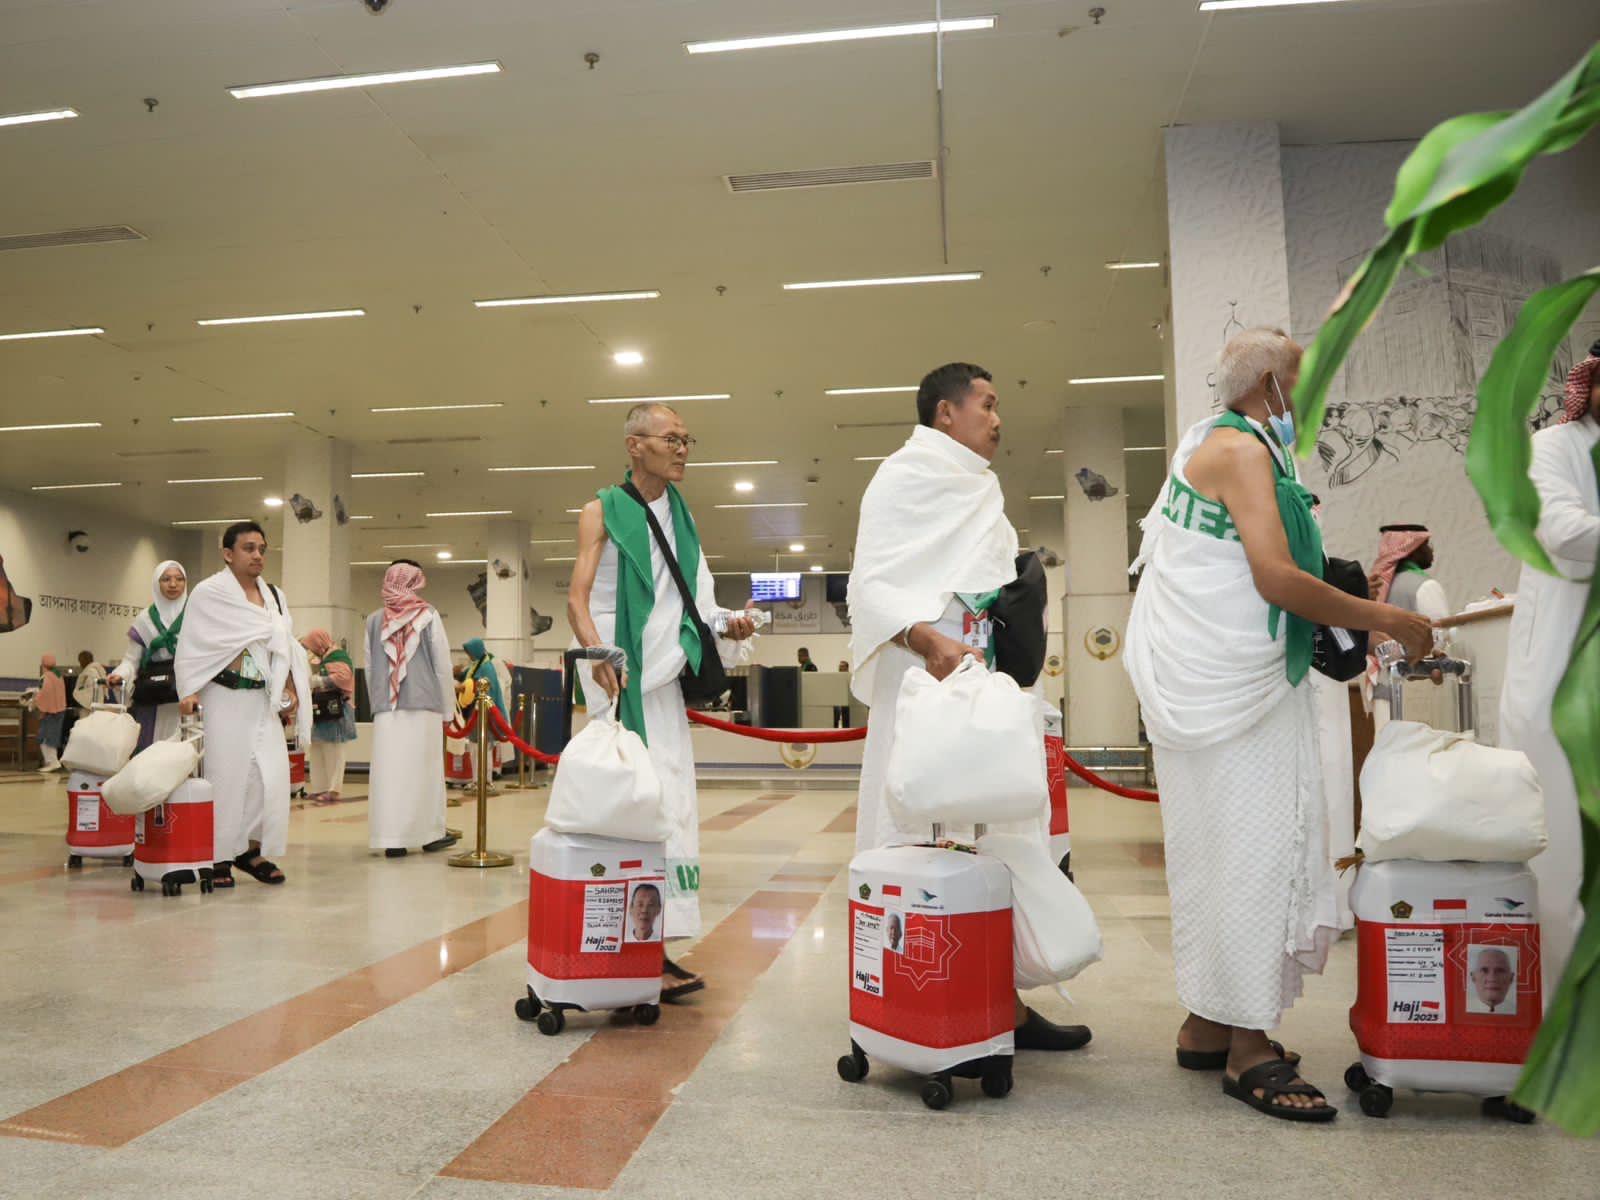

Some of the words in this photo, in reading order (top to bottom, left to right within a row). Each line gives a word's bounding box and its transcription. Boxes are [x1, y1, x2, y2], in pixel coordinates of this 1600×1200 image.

[585, 936, 605, 950] Haji
[856, 970, 870, 989] Haji
[1393, 1000, 1420, 1021] Haji
